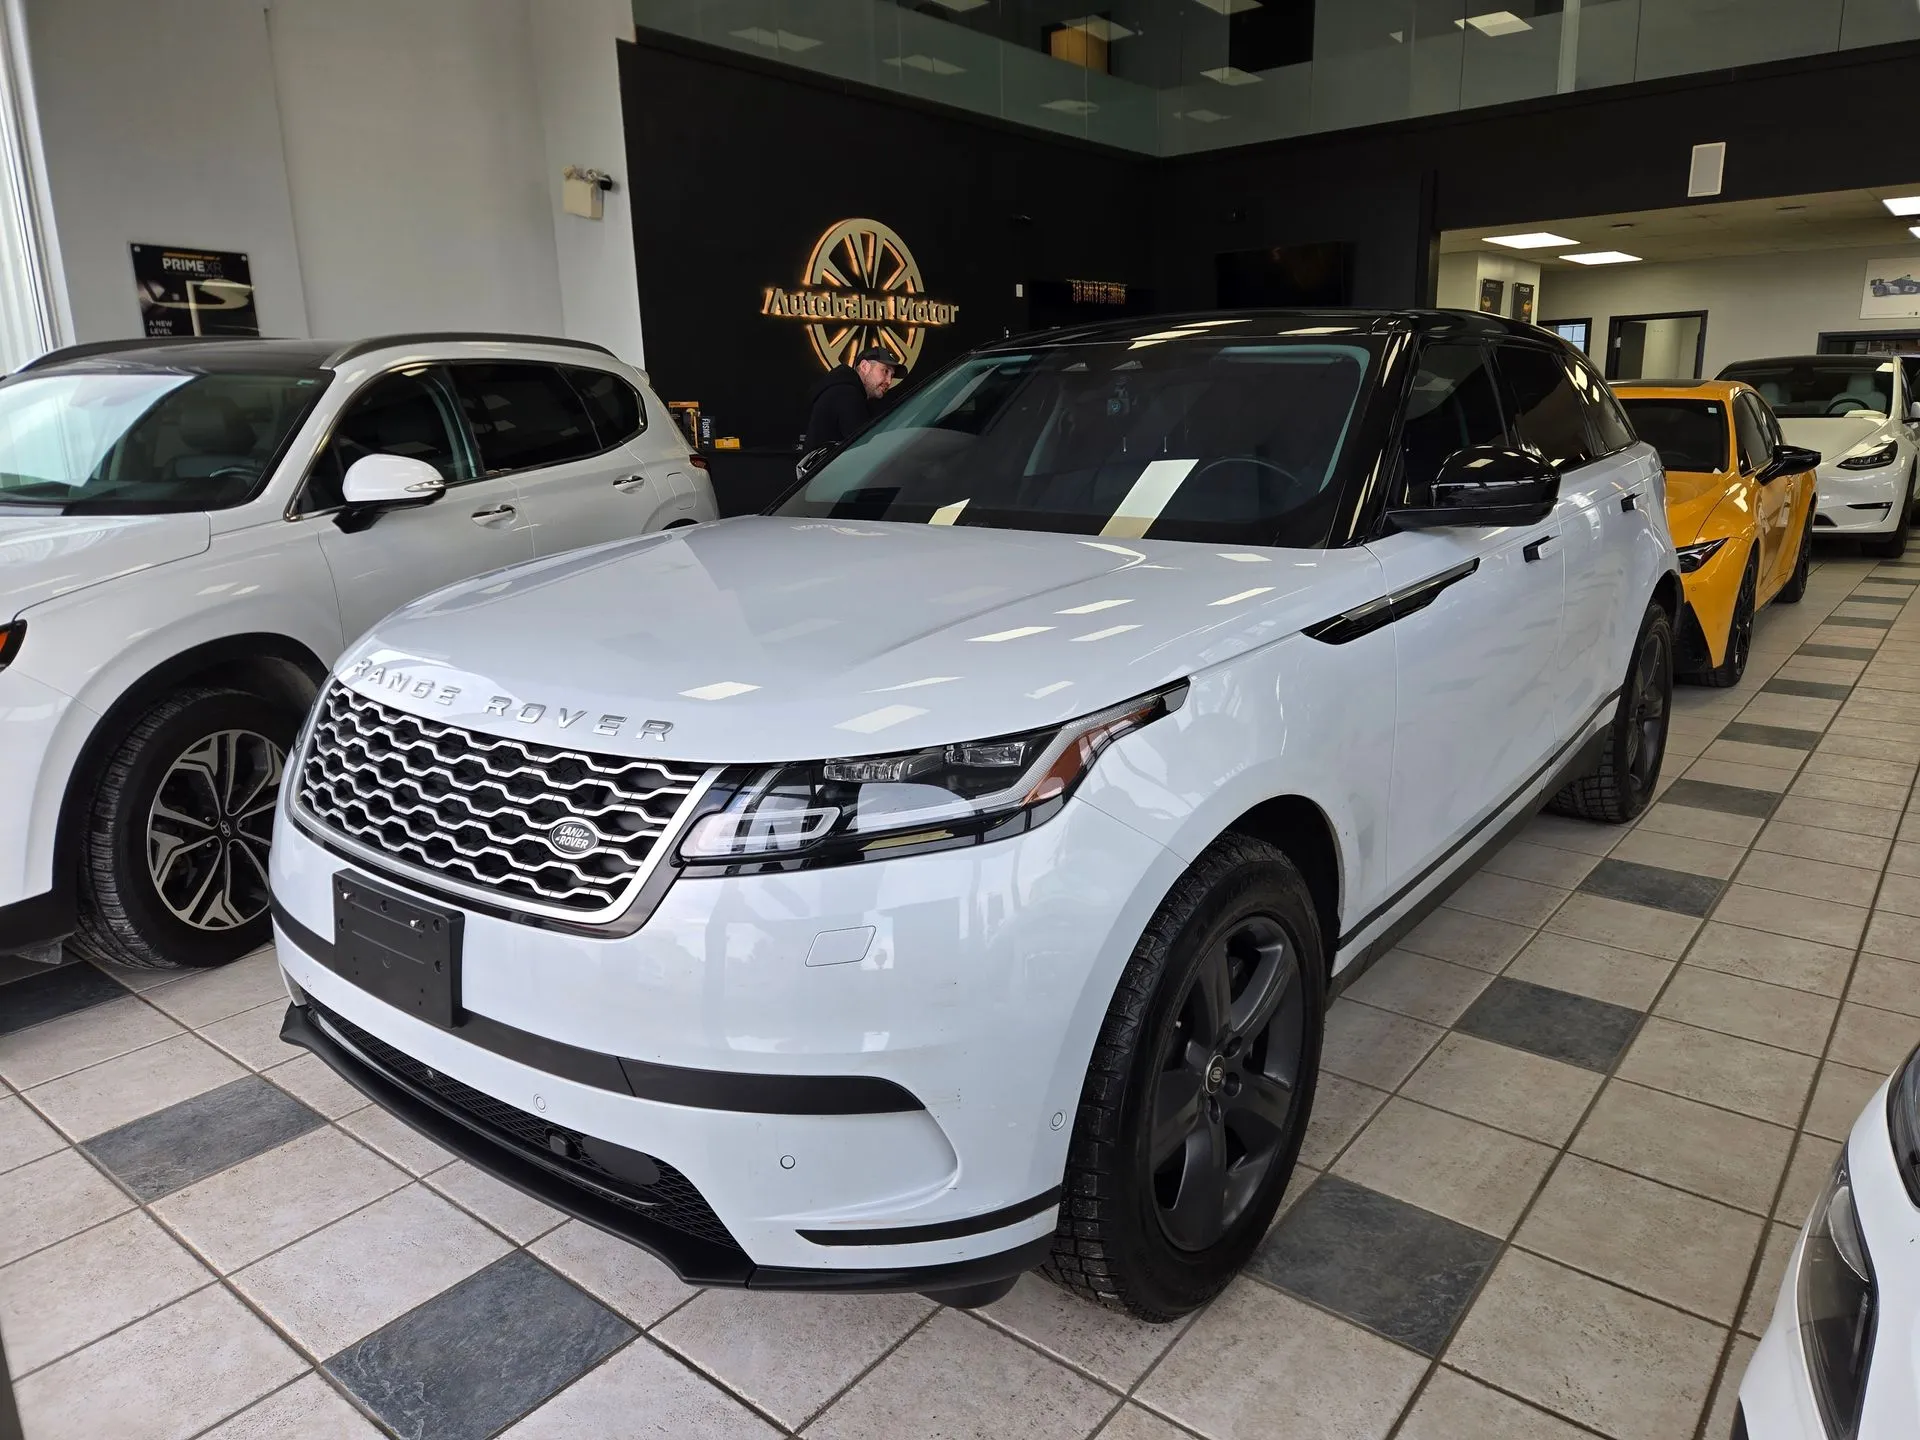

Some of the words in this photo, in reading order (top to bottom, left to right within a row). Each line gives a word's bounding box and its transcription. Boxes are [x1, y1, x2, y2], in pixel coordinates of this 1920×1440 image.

[768, 287, 889, 320] Autobahn
[896, 296, 959, 323] Motor
[156, 319, 173, 328] NEW
[150, 327, 172, 336] LEVEL
[352, 658, 462, 706] RANGE
[481, 695, 675, 743] ROVER
[560, 825, 585, 838] LAND
[558, 835, 589, 849] ROVER
